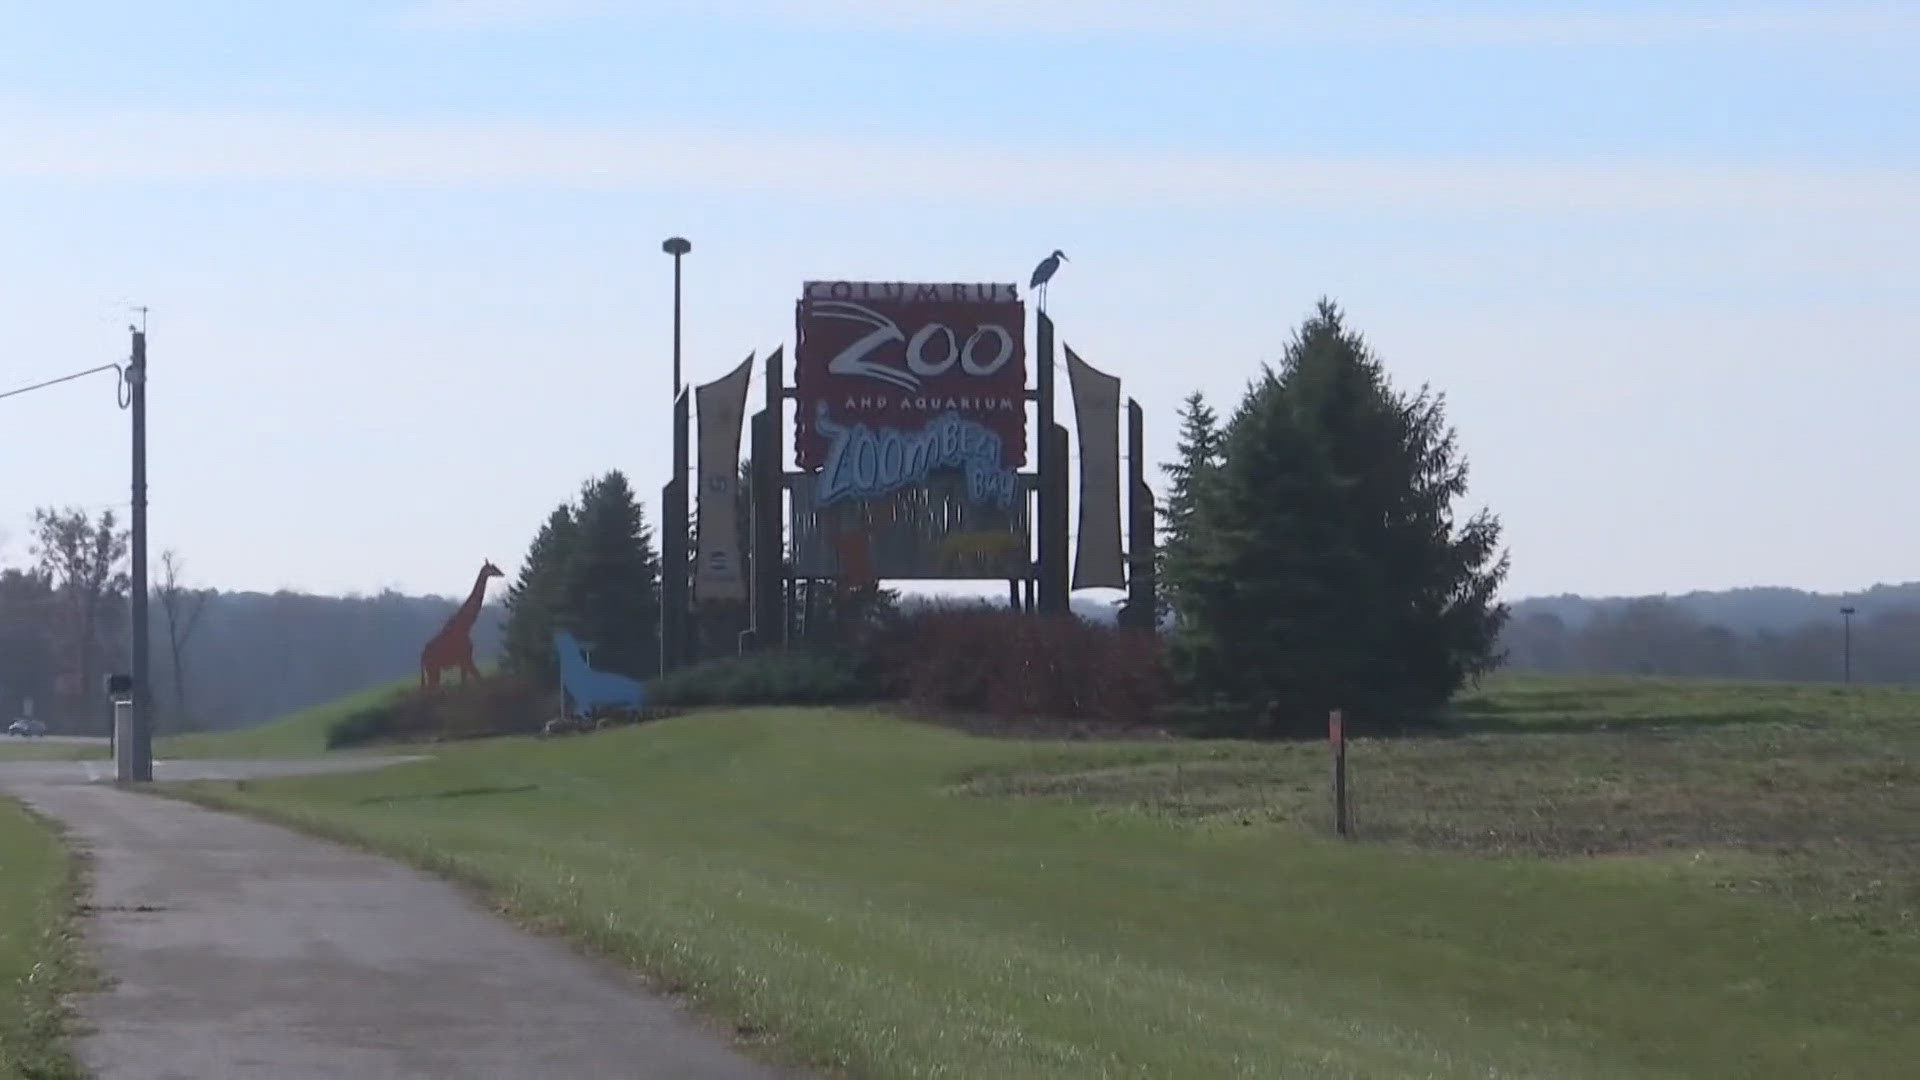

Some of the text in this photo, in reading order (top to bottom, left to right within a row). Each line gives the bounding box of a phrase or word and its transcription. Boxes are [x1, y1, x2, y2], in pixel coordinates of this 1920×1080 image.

[806, 282, 1019, 302] COLUMBUS
[811, 300, 1014, 392] ZOO
[845, 396, 1014, 411] AND AQUARIUM
